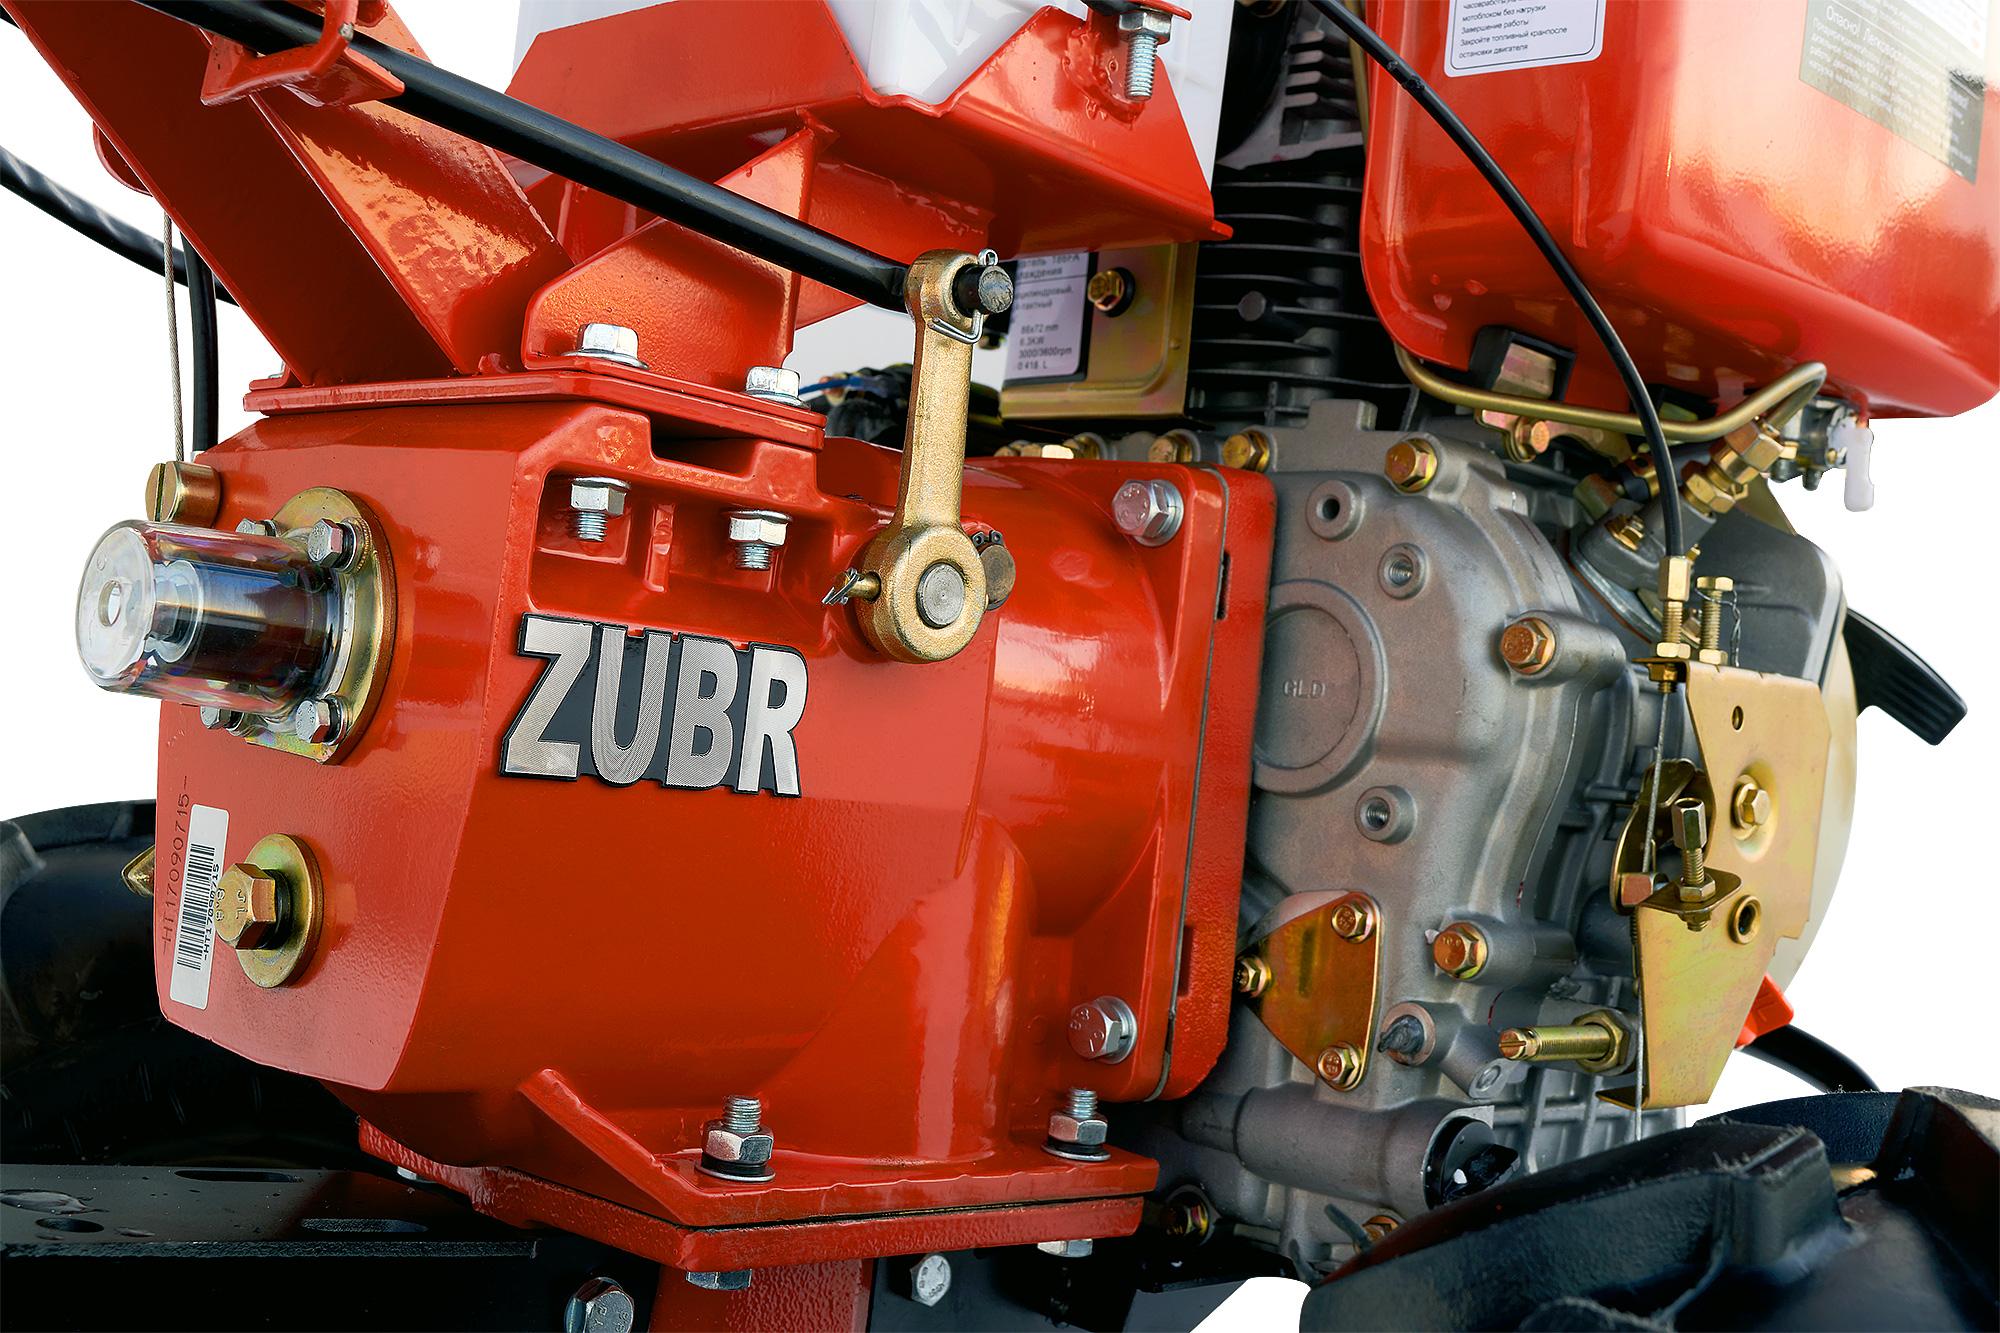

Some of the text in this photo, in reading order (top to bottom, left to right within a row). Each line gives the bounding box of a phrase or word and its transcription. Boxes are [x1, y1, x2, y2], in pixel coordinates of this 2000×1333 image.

[1503, 8, 1515, 16] без
[1503, 19, 1529, 30] работы
[502, 613, 808, 797] ZUBR
